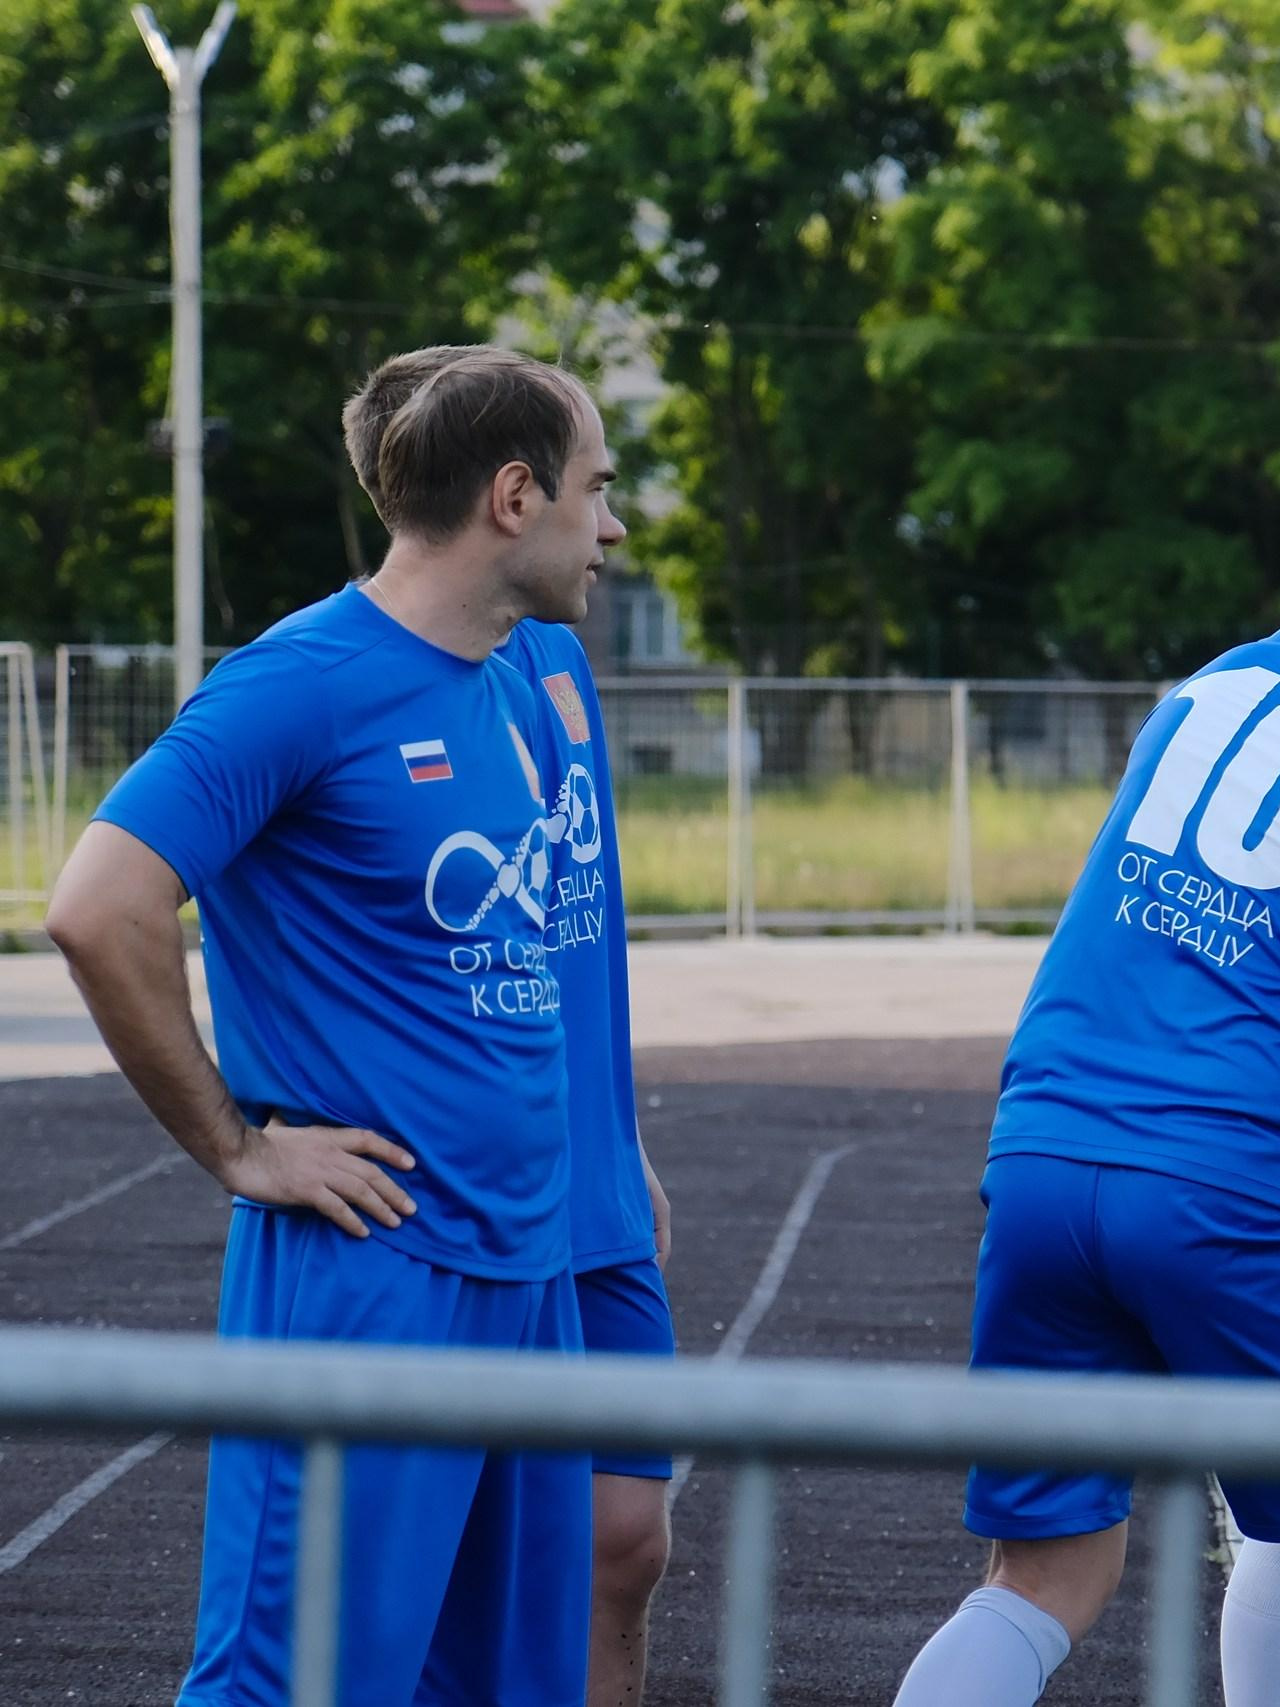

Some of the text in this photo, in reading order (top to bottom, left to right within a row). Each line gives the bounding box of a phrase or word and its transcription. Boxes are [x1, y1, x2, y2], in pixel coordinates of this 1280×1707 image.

[1117, 852, 1274, 938] ОТ СЕРДЦА
[1114, 894, 1255, 968] К СЕРДЦУ
[449, 942, 492, 974] ОТ
[470, 984, 494, 1017] К
